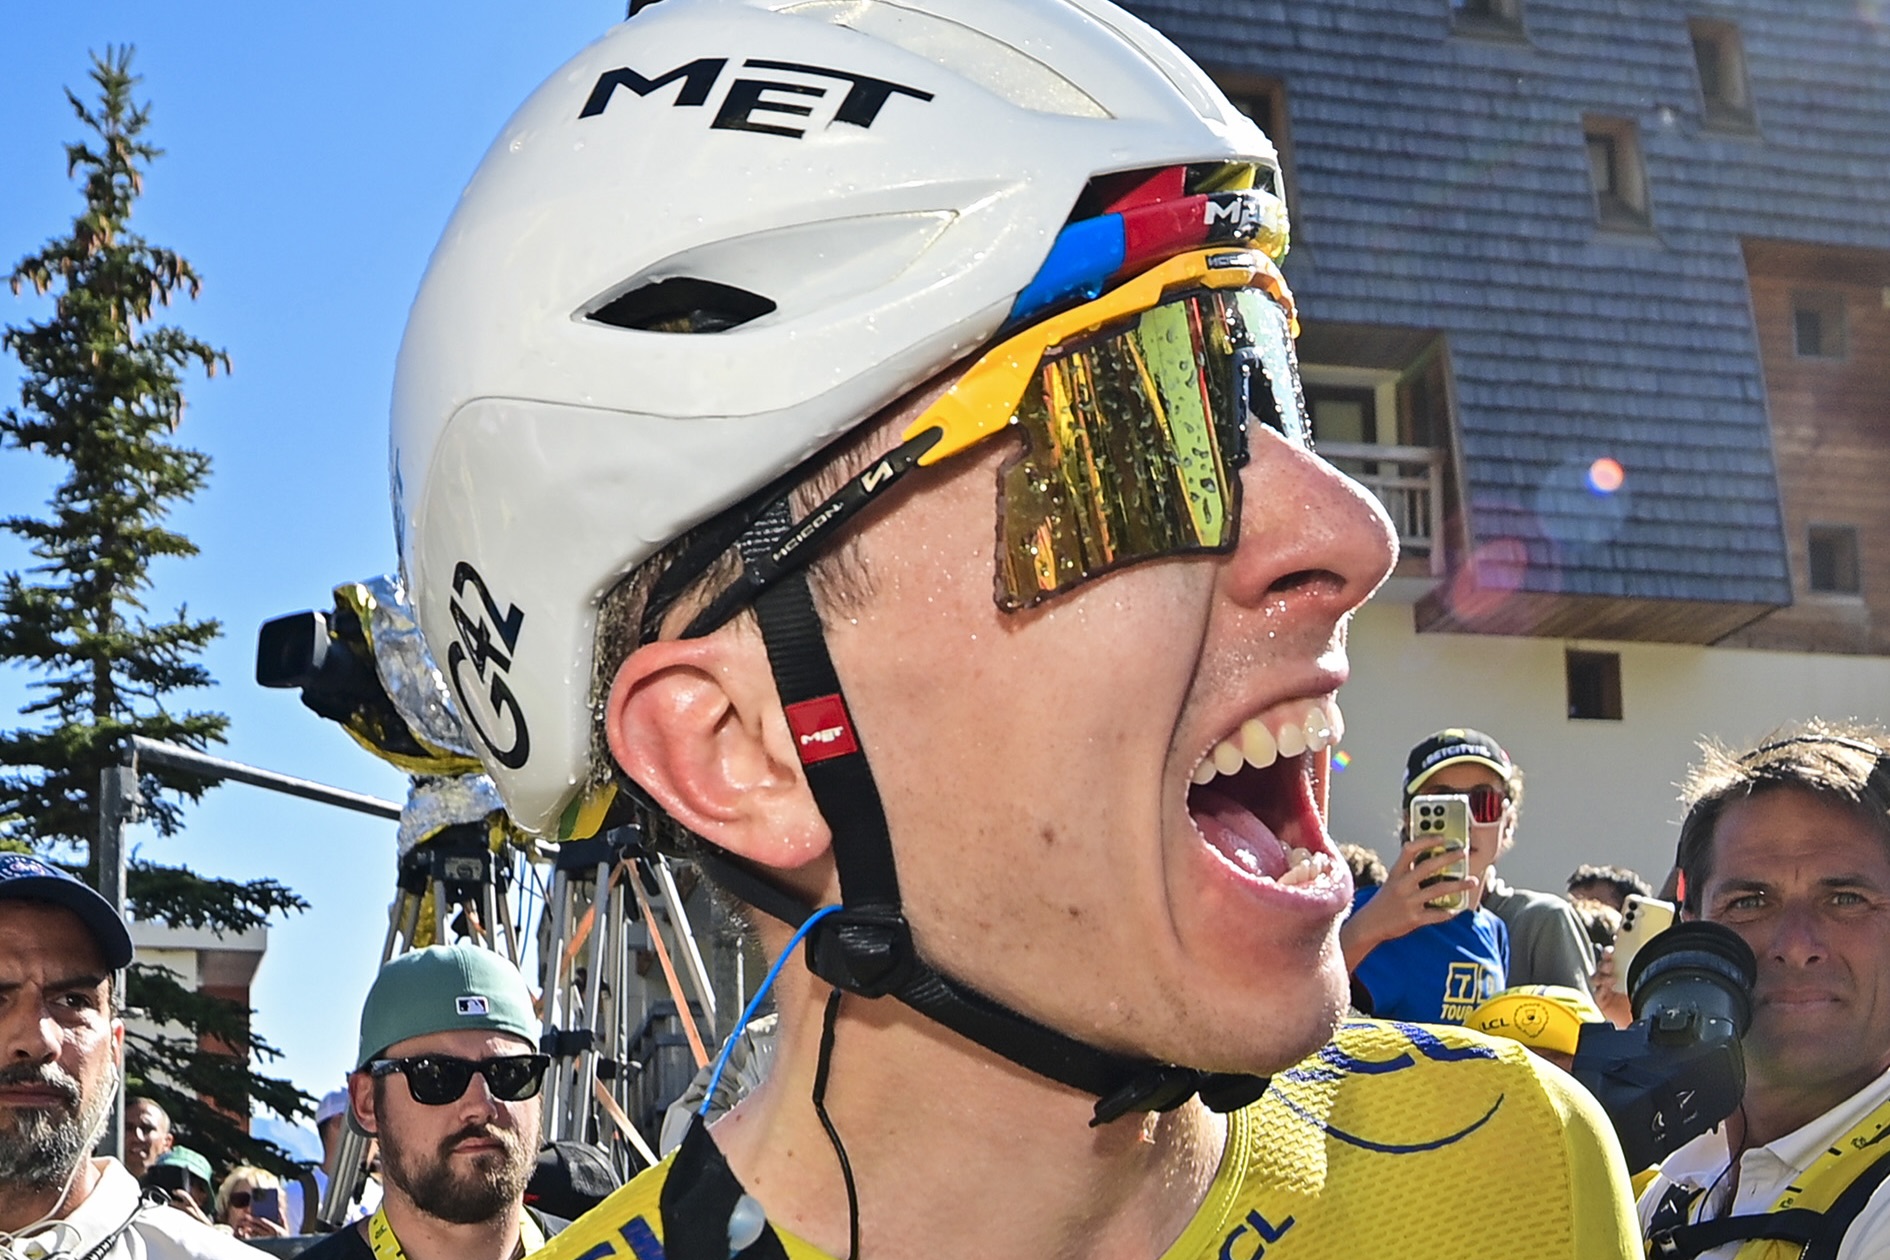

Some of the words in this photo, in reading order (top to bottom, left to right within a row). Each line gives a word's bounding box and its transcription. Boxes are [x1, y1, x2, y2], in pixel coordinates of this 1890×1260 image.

[578, 57, 936, 140] MET
[448, 560, 530, 770] G42
[800, 725, 844, 746] MET
[1481, 1017, 1510, 1031] LCL
